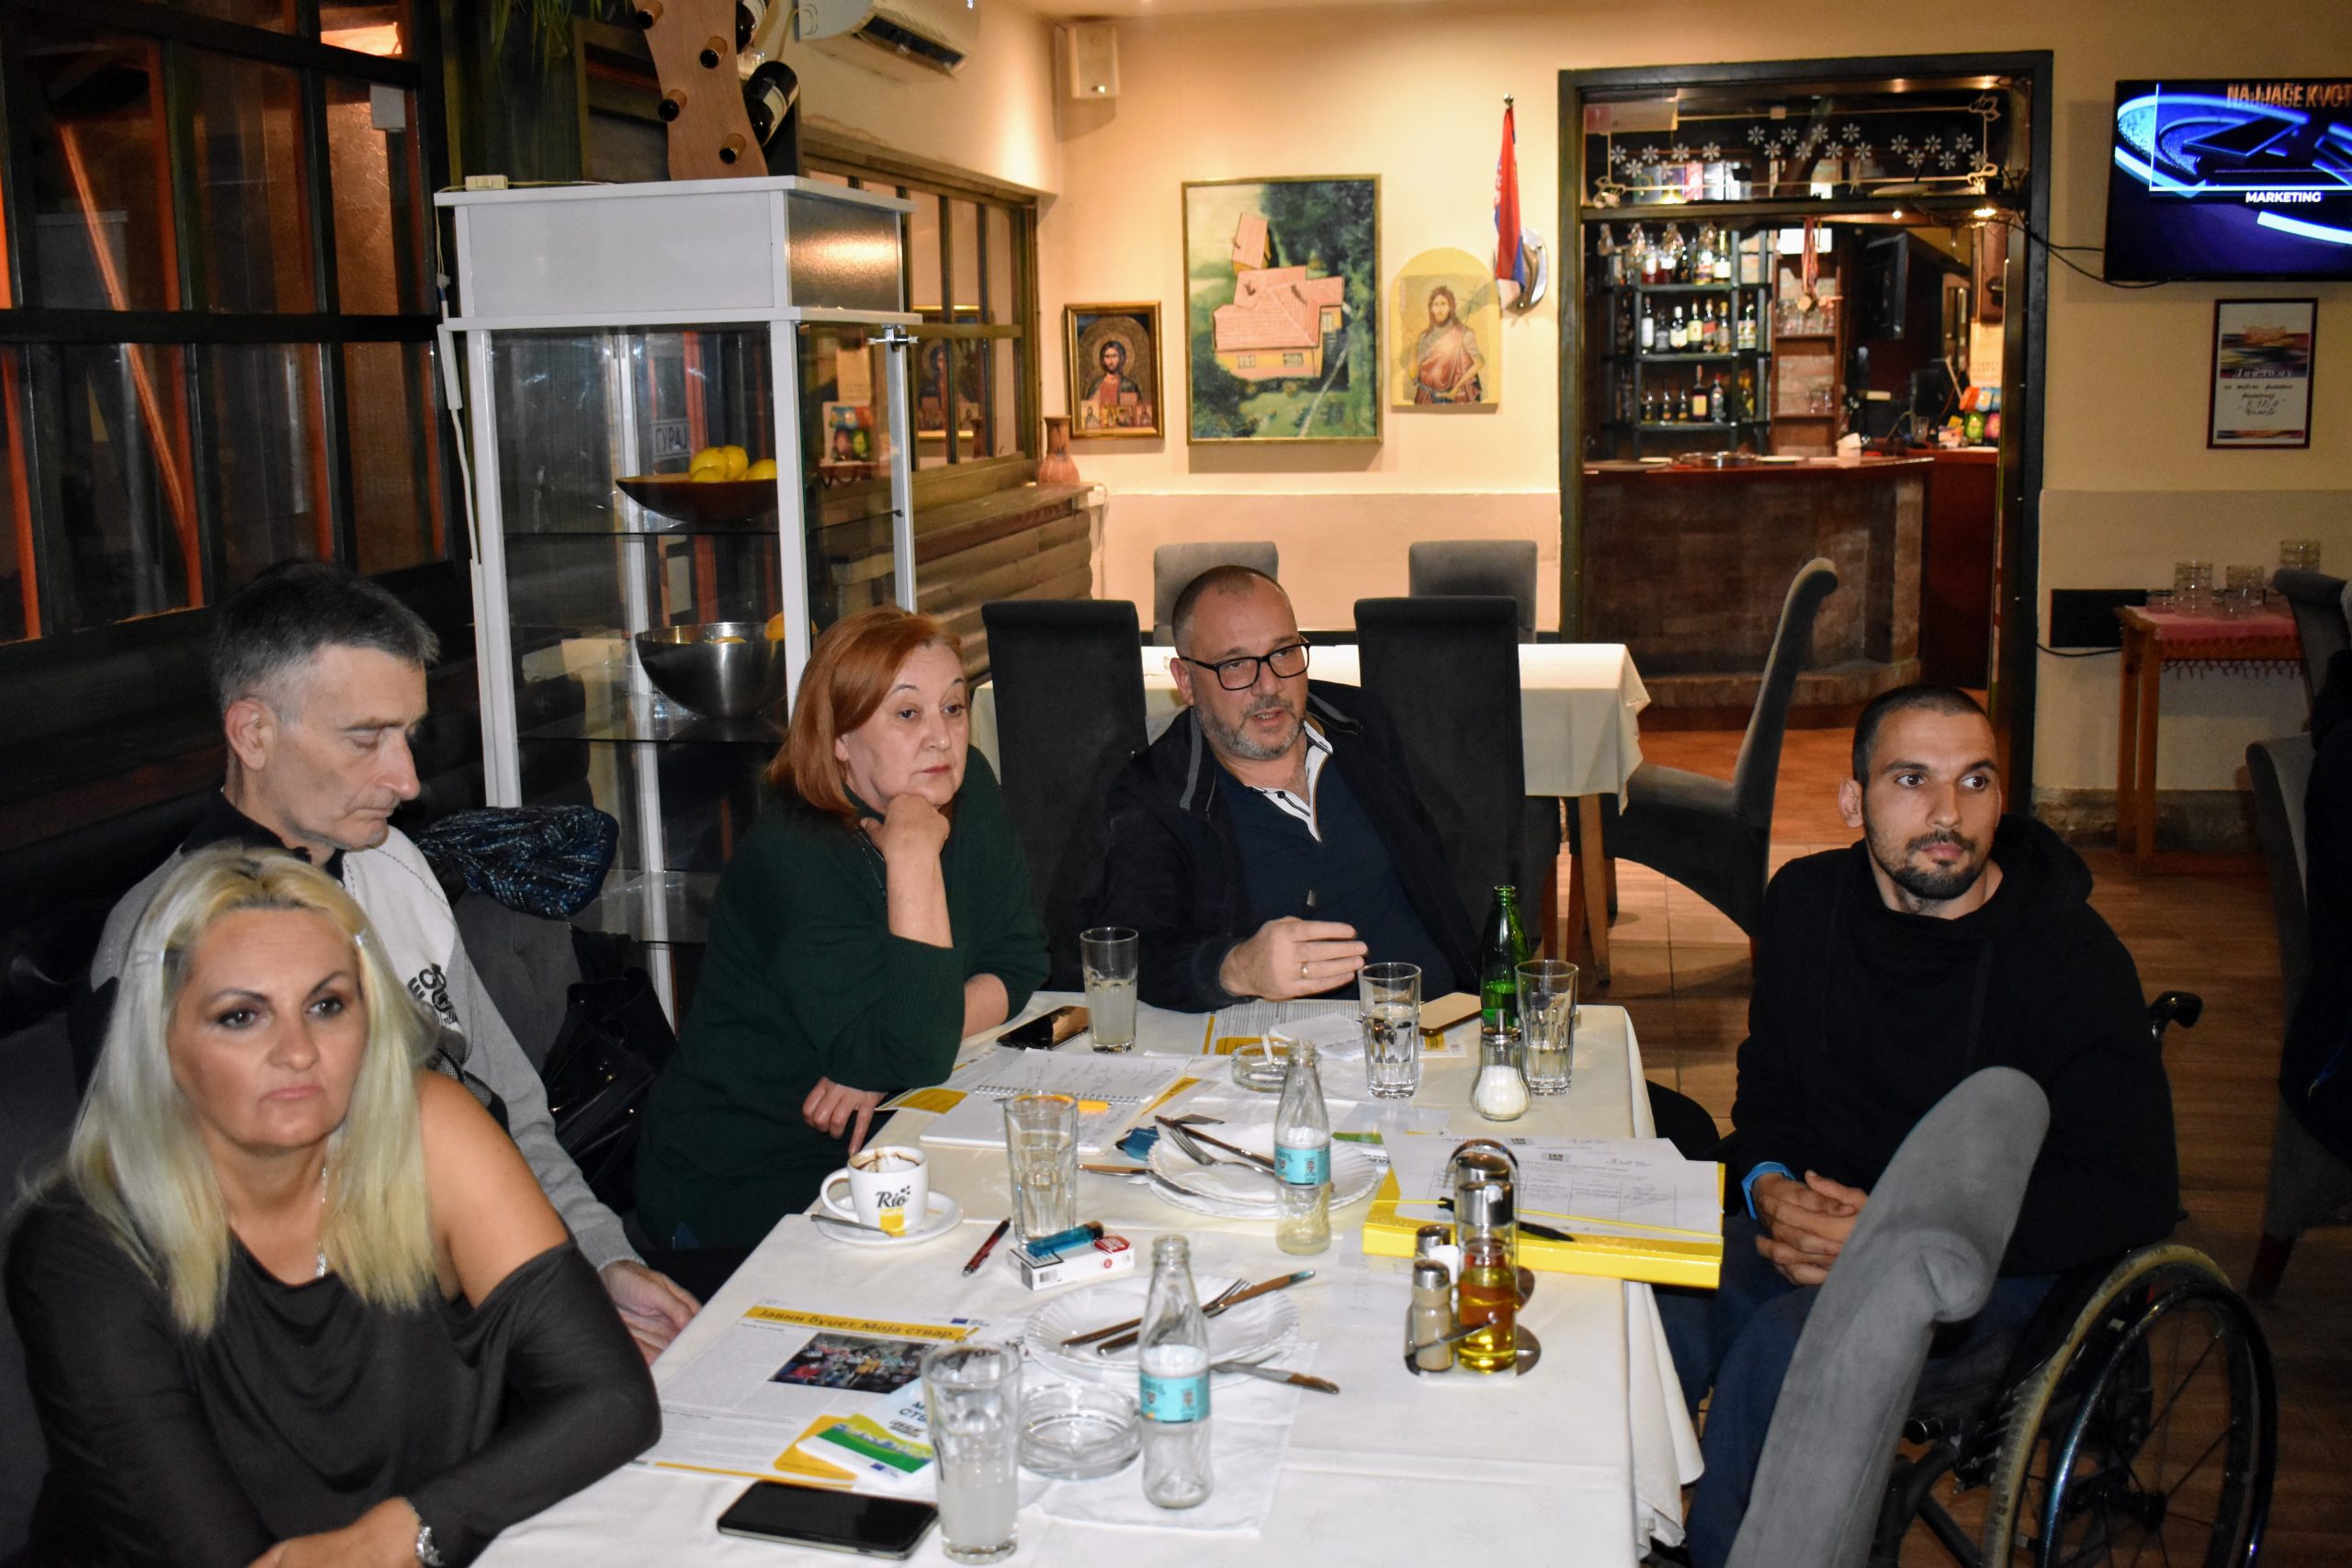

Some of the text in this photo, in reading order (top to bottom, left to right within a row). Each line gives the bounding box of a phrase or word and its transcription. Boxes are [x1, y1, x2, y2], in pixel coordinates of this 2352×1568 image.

[2245, 191, 2322, 203] MARKETING
[655, 426, 688, 453] ГУРАЈ
[876, 1190, 908, 1208] Rio
[860, 1321, 901, 1335] Моја
